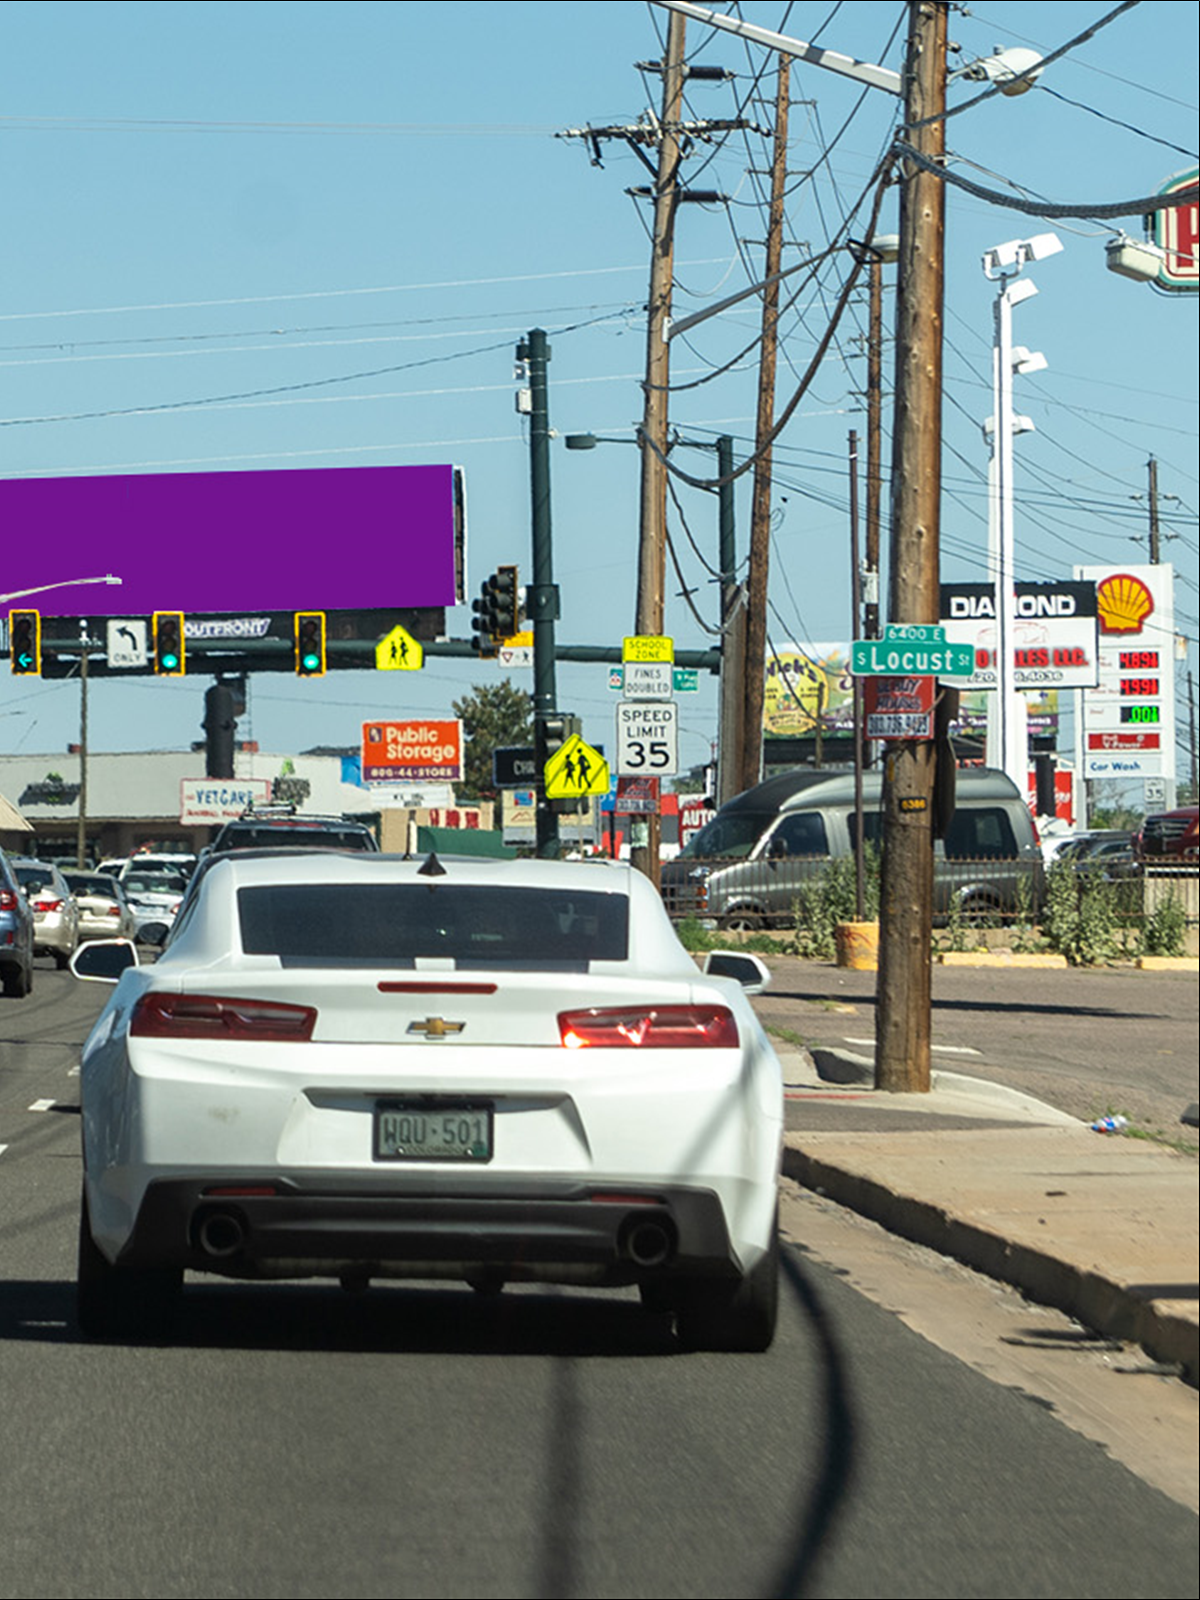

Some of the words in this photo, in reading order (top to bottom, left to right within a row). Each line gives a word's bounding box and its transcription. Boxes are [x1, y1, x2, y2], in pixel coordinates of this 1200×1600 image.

[950, 595, 1076, 618] DIAOND
[888, 628, 927, 640] 6400
[933, 628, 942, 641] E
[629, 640, 667, 650] SCHOOL
[113, 652, 143, 663] ONLY
[635, 650, 661, 660] ZONE
[857, 652, 867, 666] S
[871, 646, 954, 671] Locust
[993, 649, 1049, 668] LES
[1053, 647, 1090, 667] LLC.
[634, 668, 662, 679] FINES
[626, 682, 670, 694] DOUBLED
[622, 709, 673, 723] SPEED
[385, 726, 439, 744] Public
[627, 725, 667, 739] LIMIT
[386, 743, 456, 764] Storage
[625, 741, 670, 768] 35
[1089, 761, 1109, 772] Car
[1112, 760, 1142, 771] Wash
[1146, 787, 1164, 799] 35
